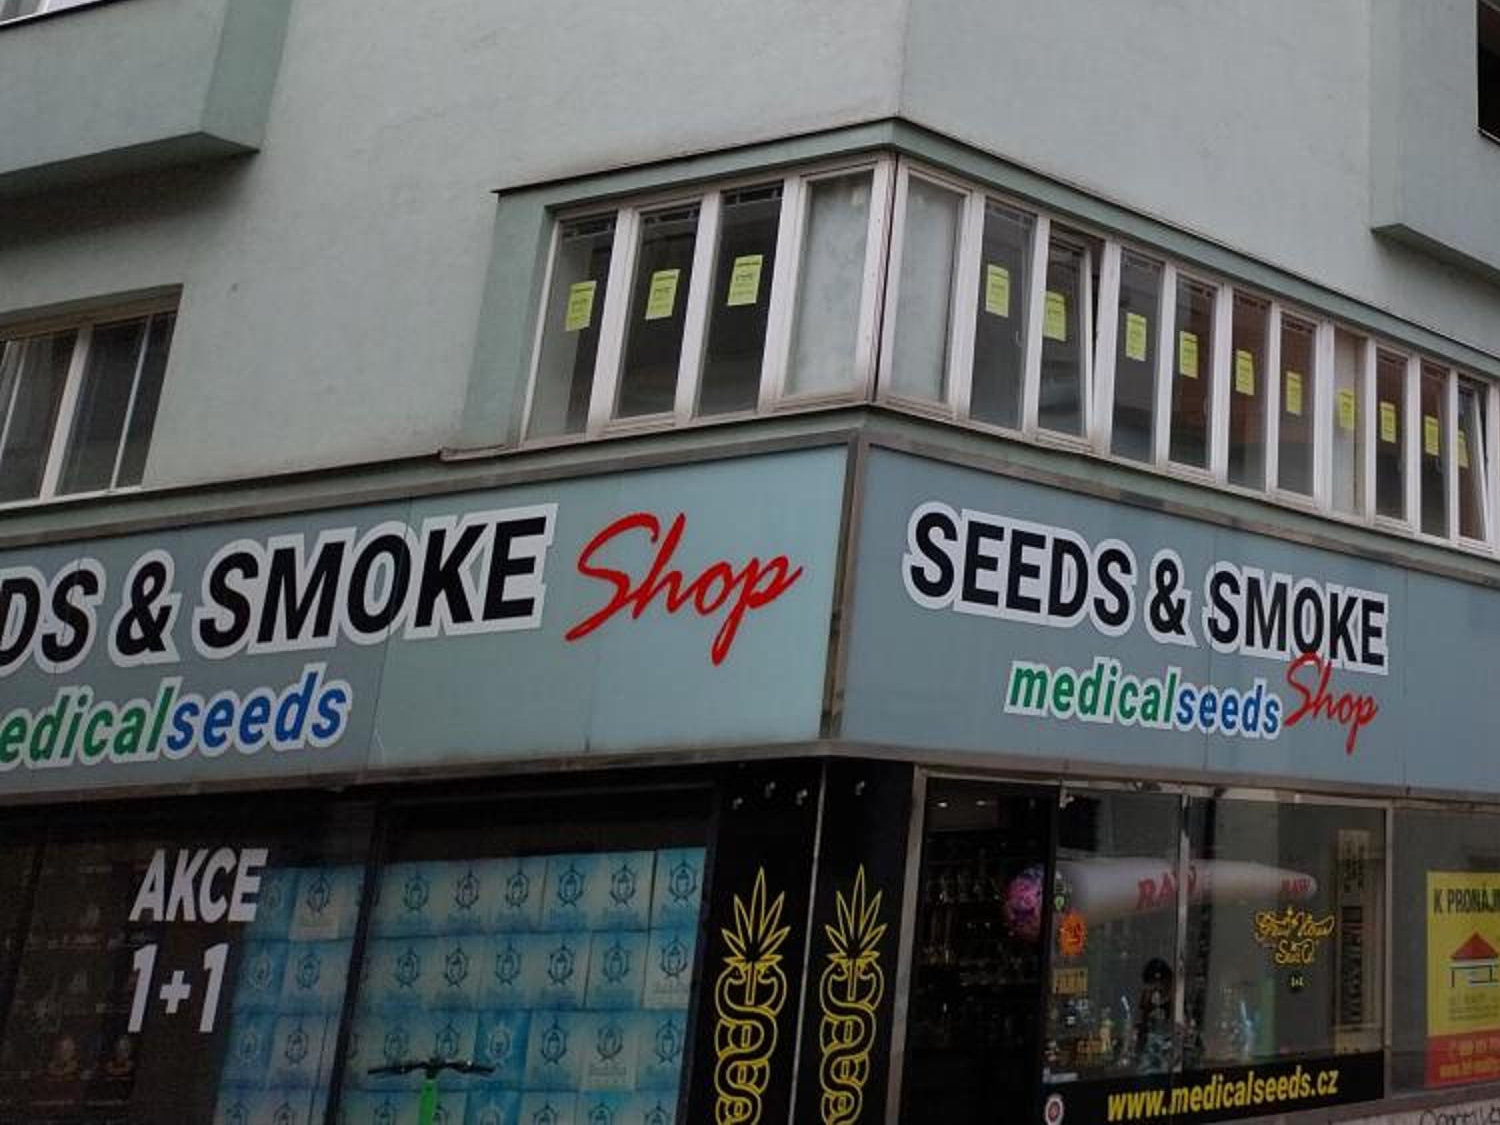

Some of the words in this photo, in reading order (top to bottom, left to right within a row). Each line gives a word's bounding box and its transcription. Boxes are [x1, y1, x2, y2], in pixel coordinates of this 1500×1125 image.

[113, 561, 172, 660] &
[198, 517, 549, 649] SMOKE
[563, 511, 805, 665] Shop
[909, 511, 1133, 627] SEEDS
[1148, 557, 1187, 636] &
[1207, 570, 1386, 667] SMOKE
[1009, 659, 1282, 736] medicalseeds
[1282, 651, 1379, 755] Shop
[128, 848, 270, 923] AKCE
[1433, 888, 1442, 914] K
[126, 941, 232, 1034] 1+1
[1106, 1065, 1340, 1122] www.medicalseeds.cz
